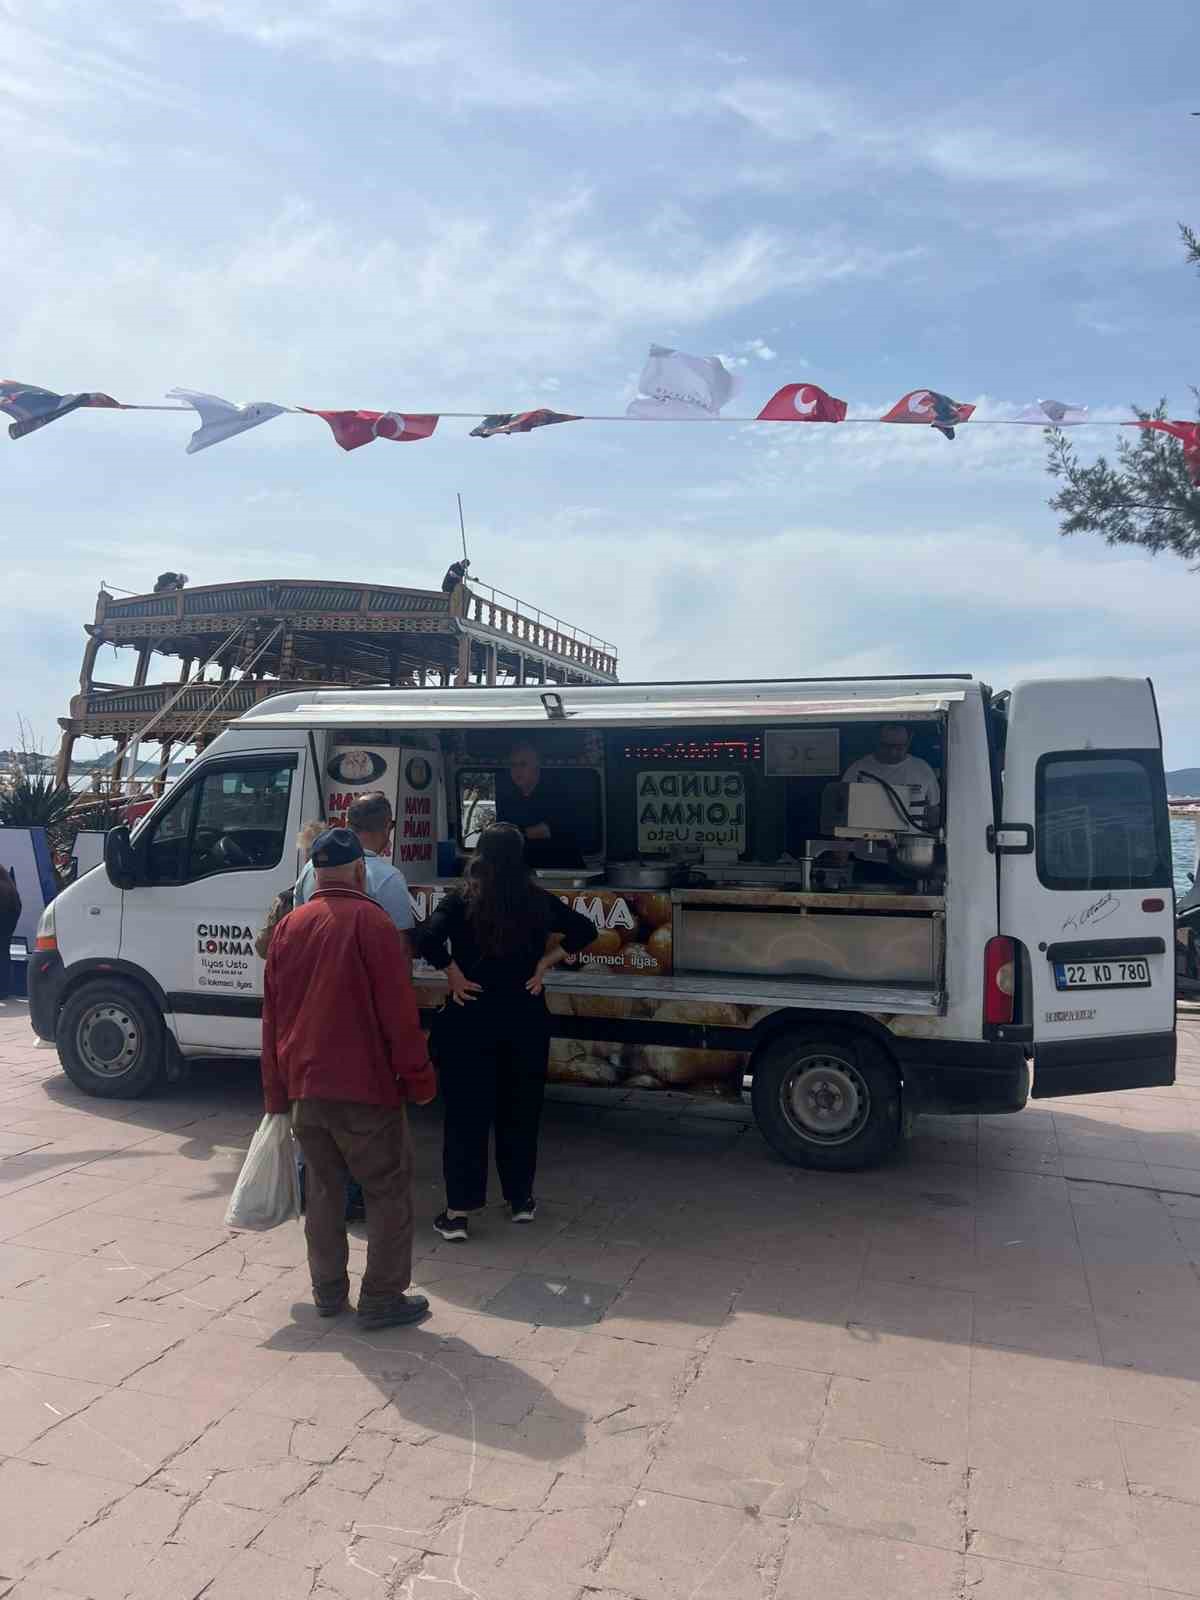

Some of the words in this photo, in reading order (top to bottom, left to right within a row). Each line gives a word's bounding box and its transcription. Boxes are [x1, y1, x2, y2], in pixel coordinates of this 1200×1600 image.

[197, 923, 253, 940] CUNDA
[198, 940, 254, 956] LOKMA
[1067, 965, 1087, 983] 22
[1093, 964, 1112, 982] KD
[1118, 963, 1146, 981] 780
